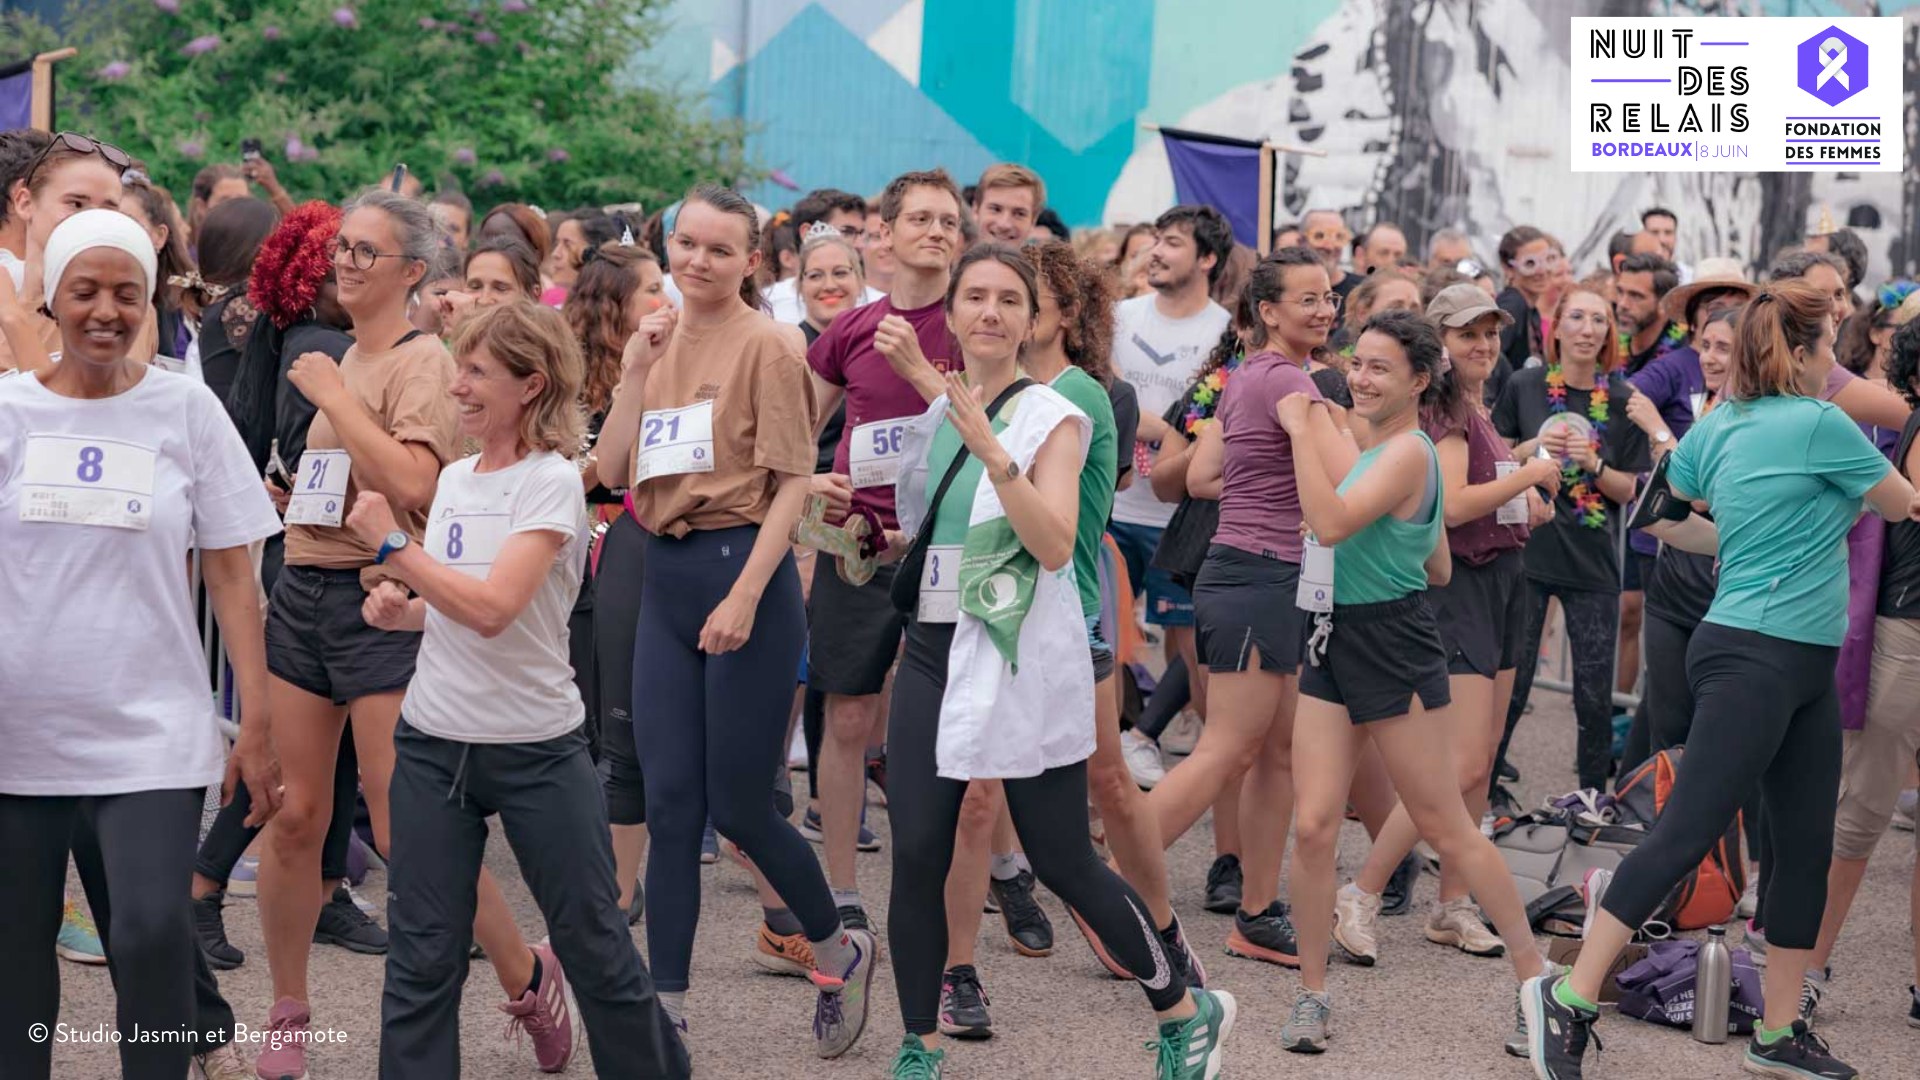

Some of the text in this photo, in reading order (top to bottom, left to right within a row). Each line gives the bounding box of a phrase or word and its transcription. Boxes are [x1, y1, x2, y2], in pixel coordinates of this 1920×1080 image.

[644, 415, 680, 447] 21
[872, 426, 904, 456] 56
[77, 446, 103, 483] 8
[306, 458, 330, 490] 21
[446, 522, 463, 559] 8
[930, 554, 940, 587] 3
